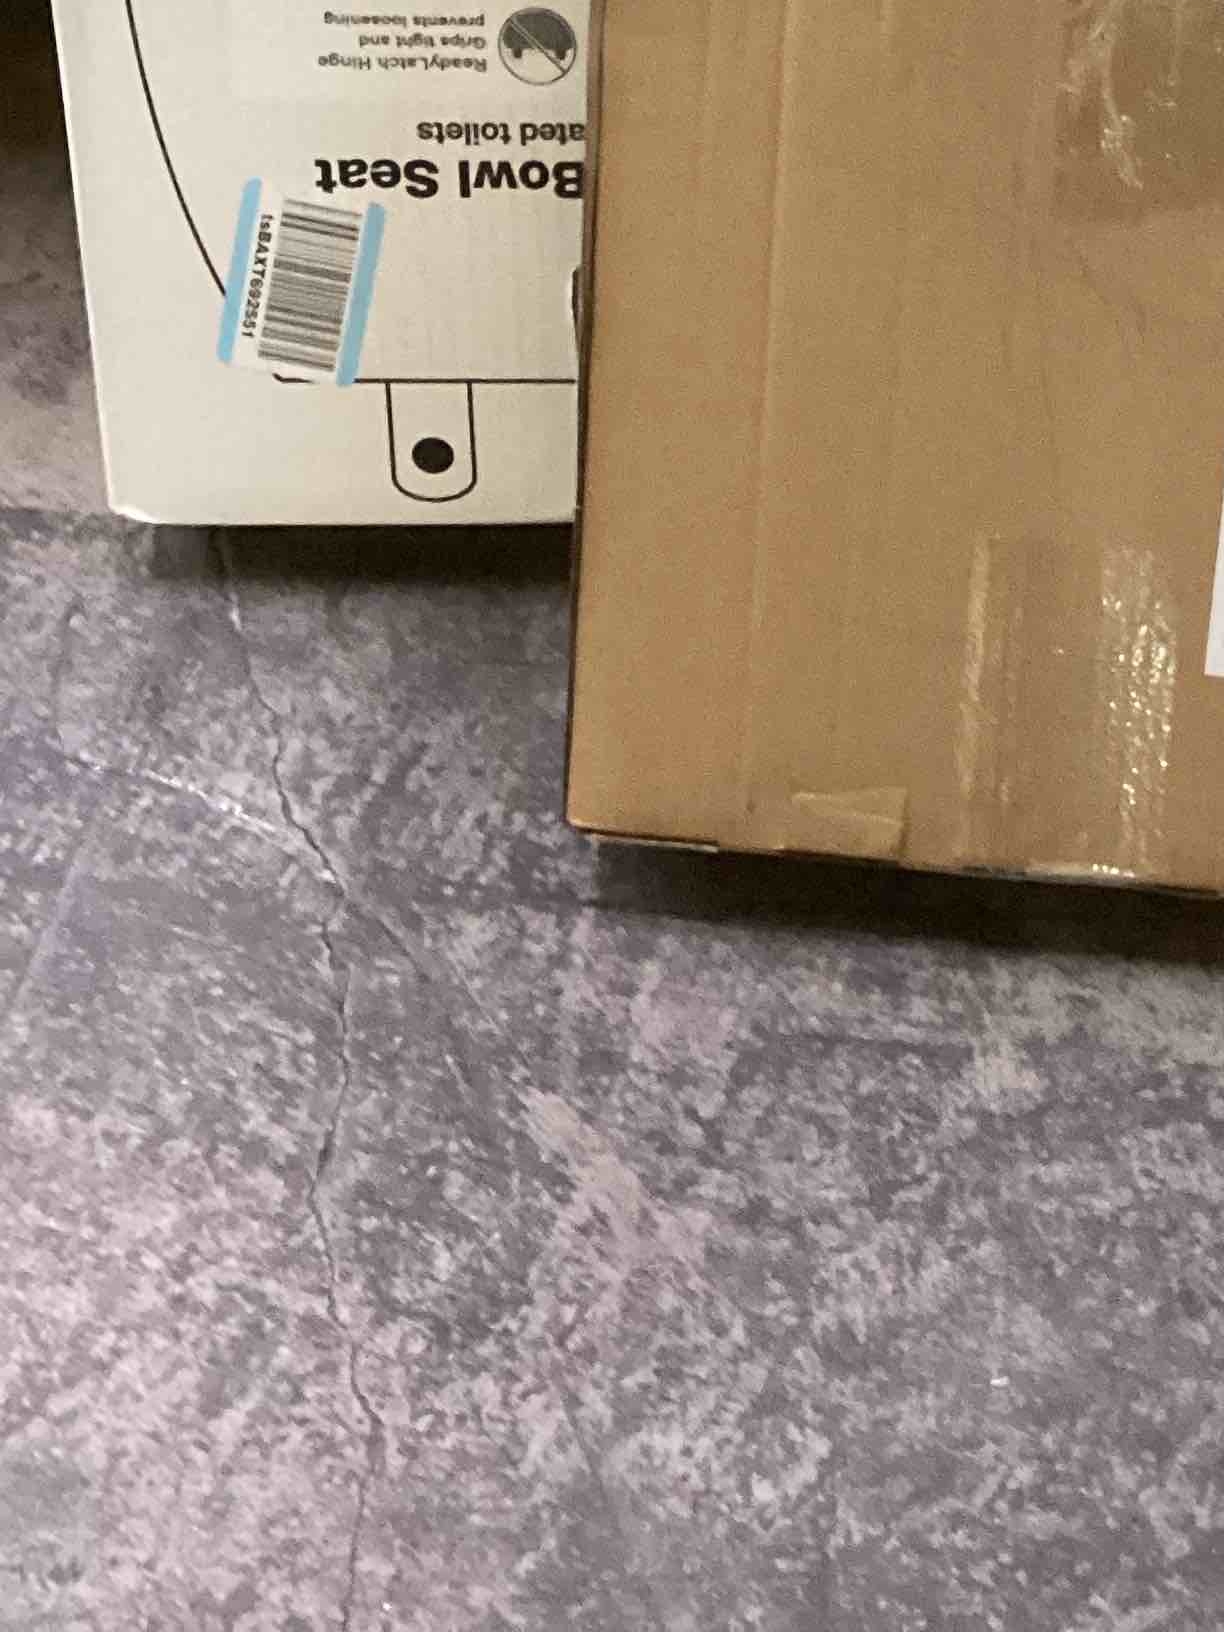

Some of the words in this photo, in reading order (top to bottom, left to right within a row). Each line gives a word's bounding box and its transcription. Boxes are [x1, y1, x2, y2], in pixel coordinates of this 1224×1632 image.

[413, 13, 486, 27] prevents
[358, 34, 391, 48] and
[317, 52, 371, 70] Hinge
[377, 54, 488, 72] ReadyLatch
[416, 121, 511, 146] toilets
[314, 158, 440, 198] Seat
[458, 159, 586, 199] Bowl
